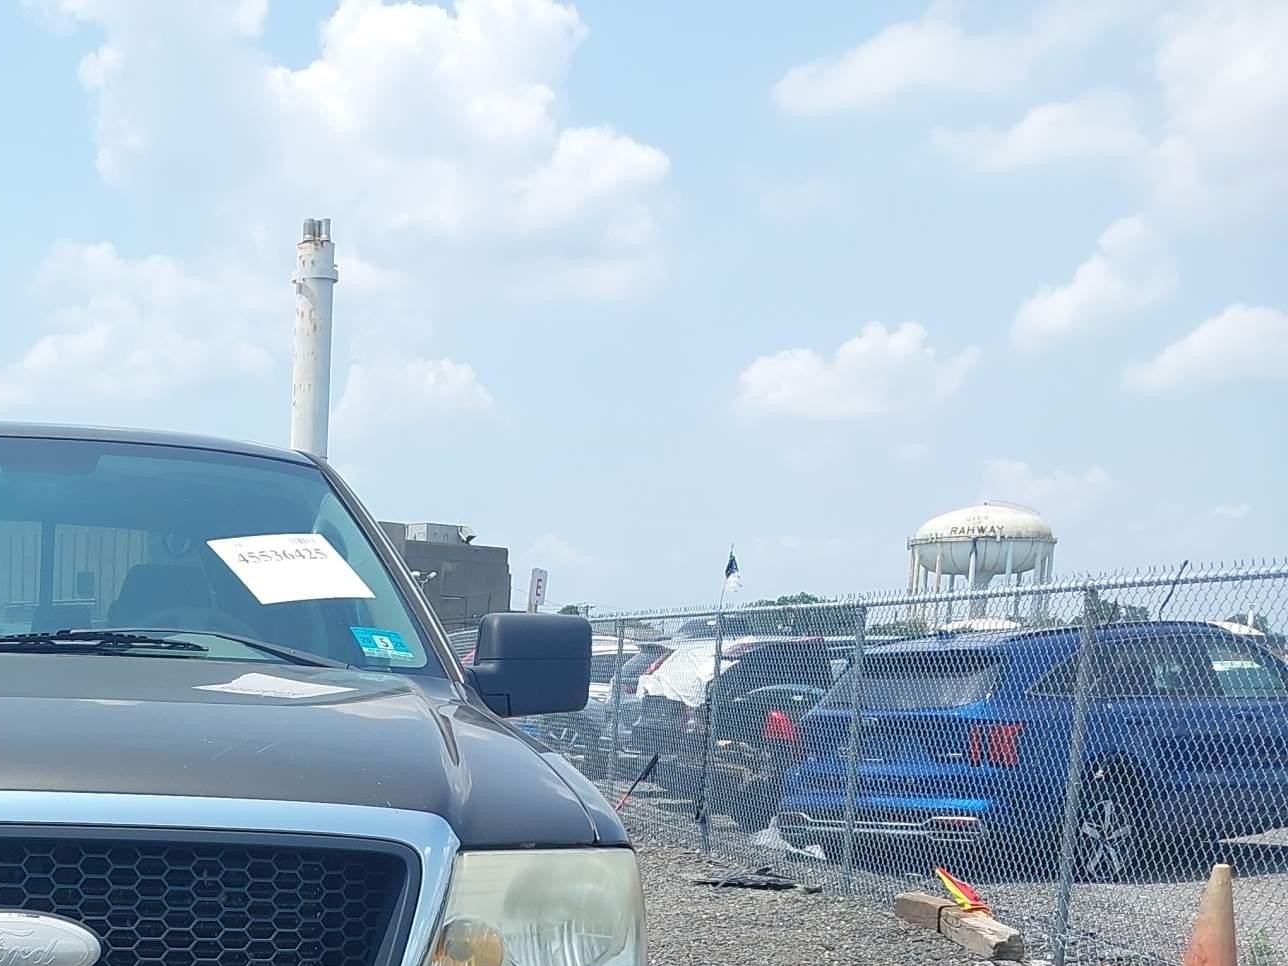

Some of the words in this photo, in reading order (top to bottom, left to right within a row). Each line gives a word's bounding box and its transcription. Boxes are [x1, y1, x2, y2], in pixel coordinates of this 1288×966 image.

[950, 525, 1005, 535] RAHWAY
[237, 547, 328, 564] 45536425
[378, 637, 390, 648] 5
